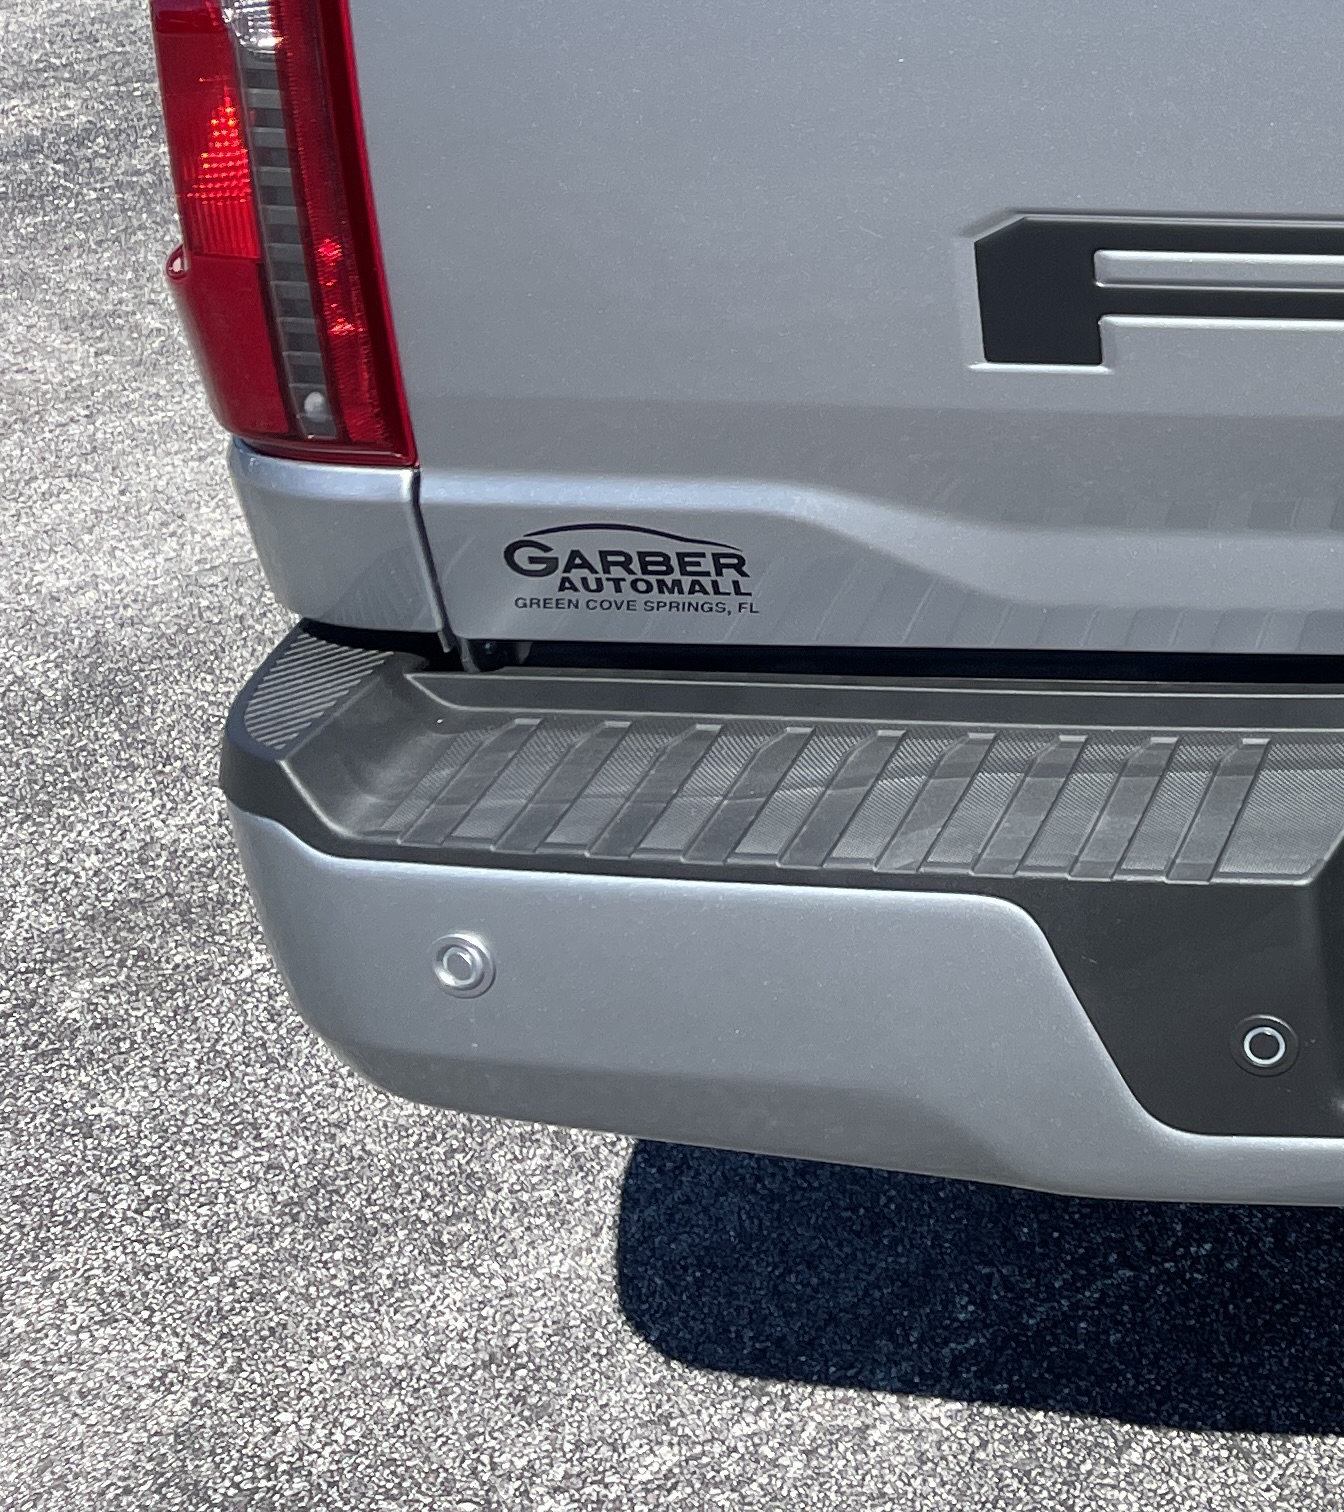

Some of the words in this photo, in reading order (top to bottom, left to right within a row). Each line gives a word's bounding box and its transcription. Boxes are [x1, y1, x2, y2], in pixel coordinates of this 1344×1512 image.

[503, 539, 751, 578] GARBER
[557, 576, 753, 597] AUTOMALL
[514, 597, 580, 610] GREEN
[585, 599, 637, 612] COVE
[643, 600, 733, 616] SPRINGS,
[738, 601, 760, 614] FL
